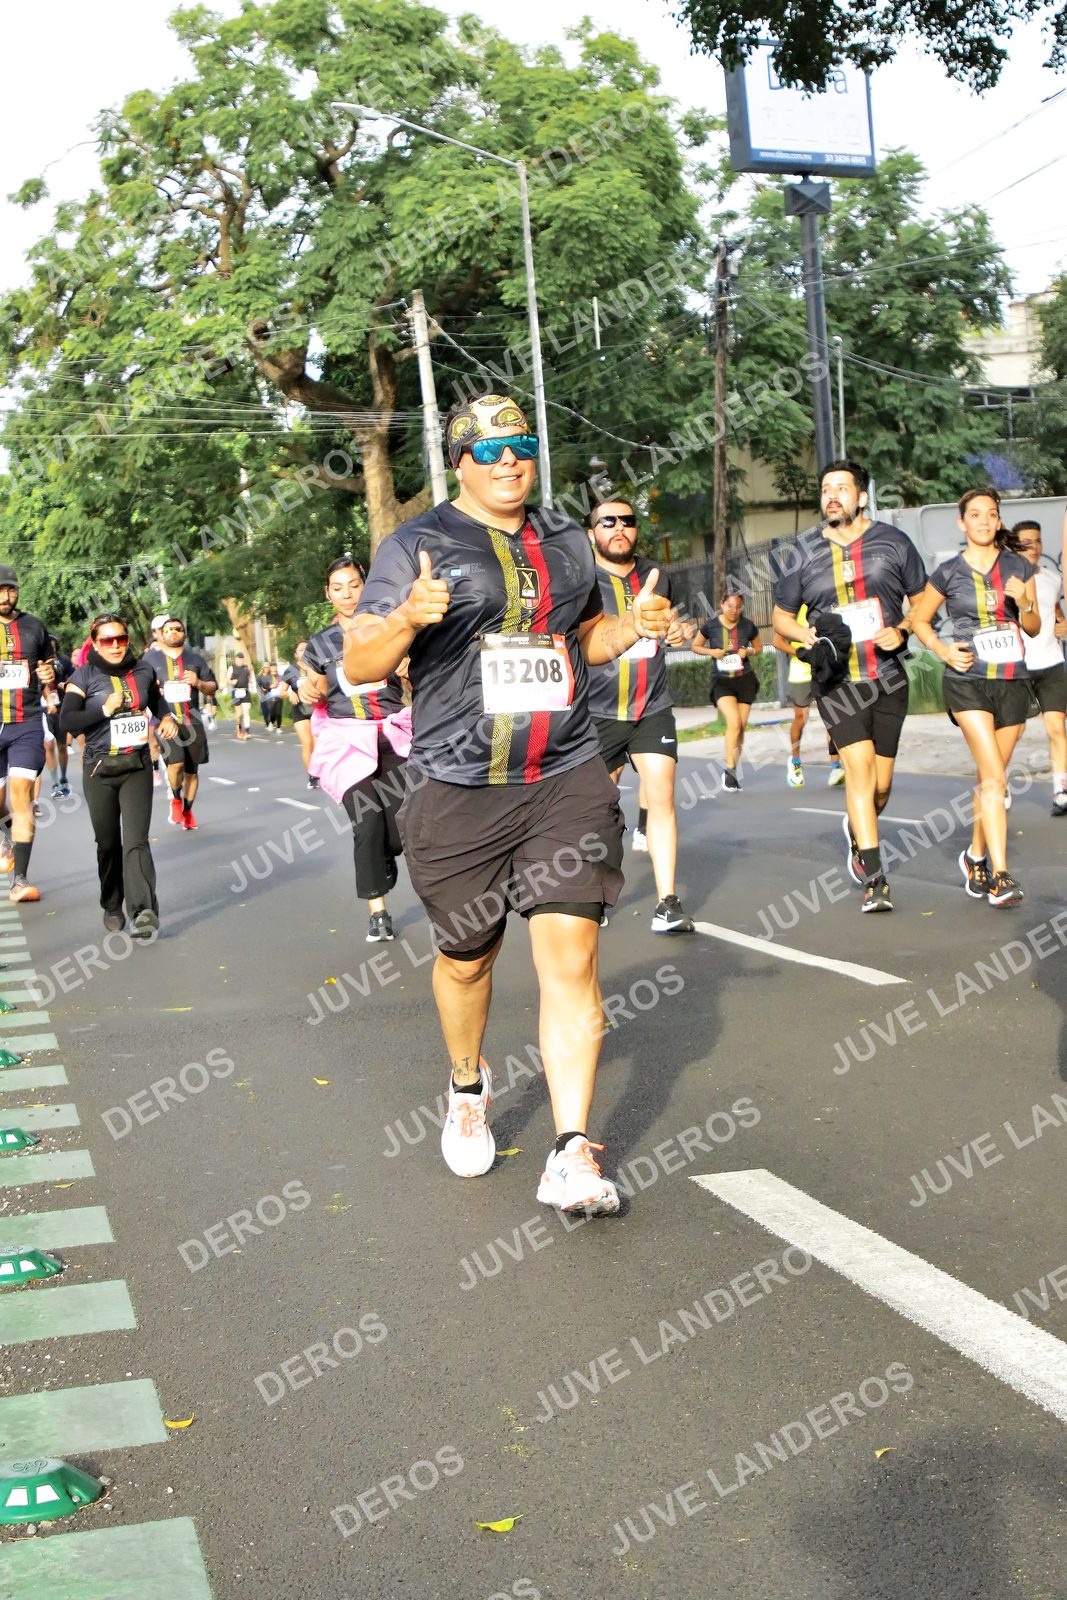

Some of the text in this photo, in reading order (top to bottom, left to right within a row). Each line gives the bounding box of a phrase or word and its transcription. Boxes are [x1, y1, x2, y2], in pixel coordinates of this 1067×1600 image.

[980, 635, 1014, 650] 11637
[487, 658, 563, 685] 13208
[114, 720, 146, 735] 12889
